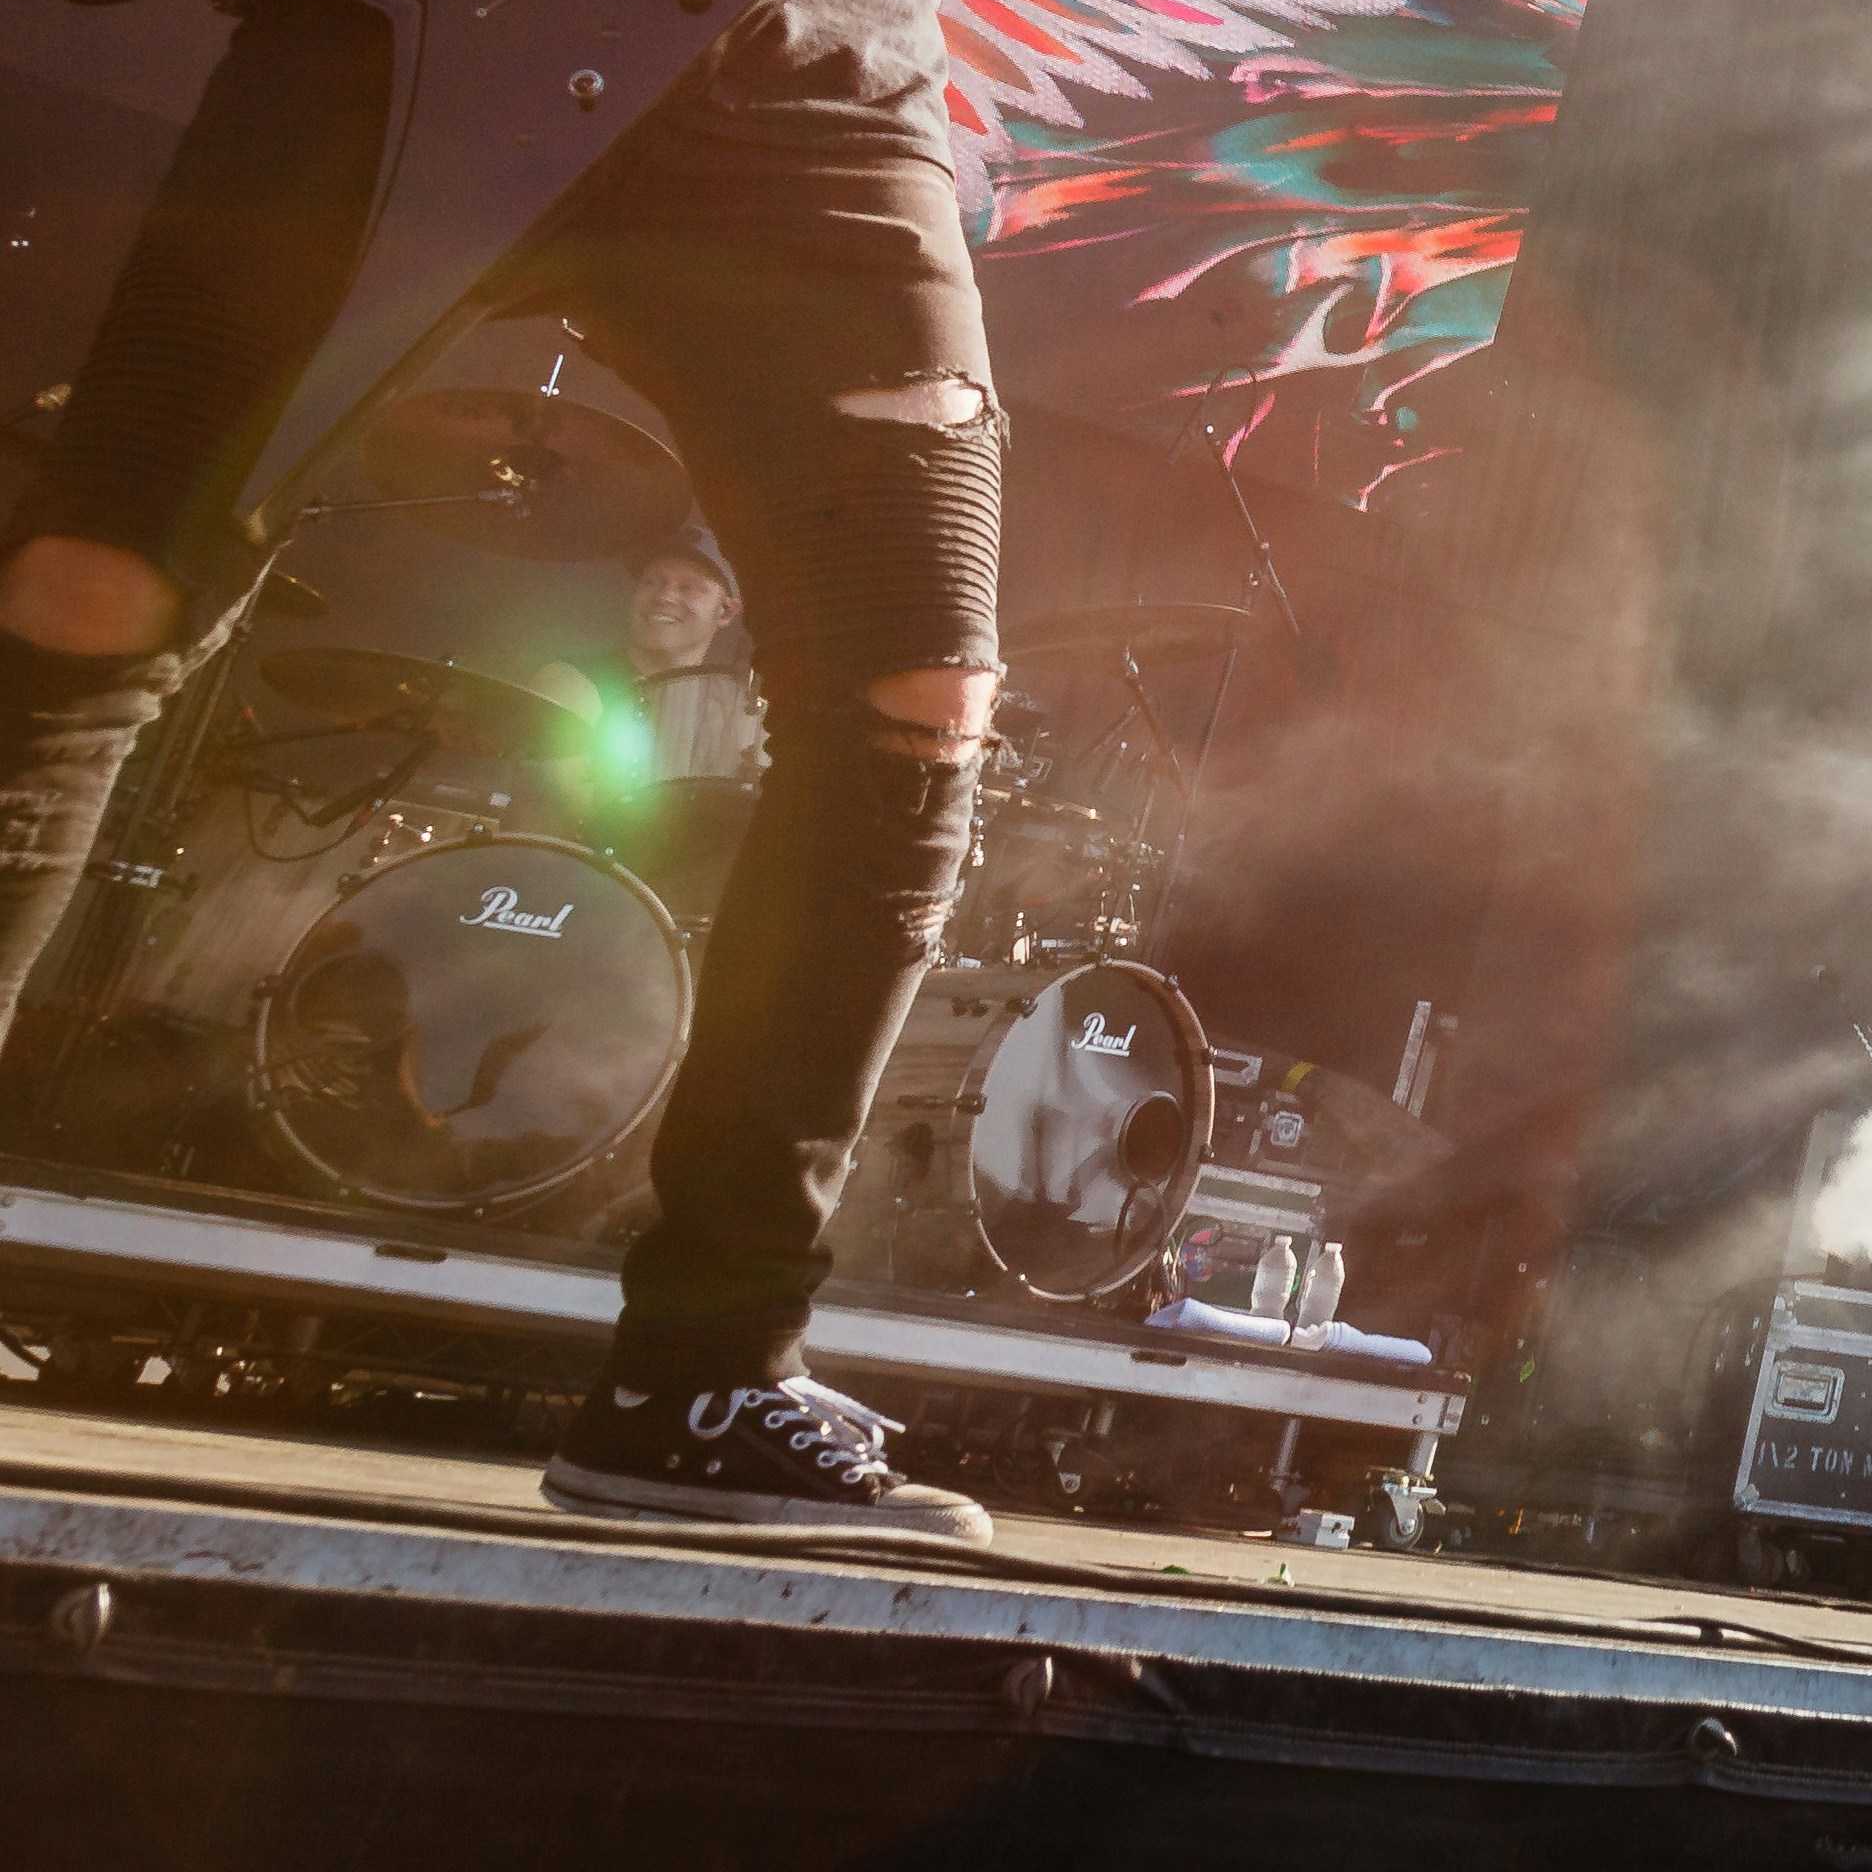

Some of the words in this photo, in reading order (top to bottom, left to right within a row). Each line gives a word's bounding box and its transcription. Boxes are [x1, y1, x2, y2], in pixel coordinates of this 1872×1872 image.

[458, 885, 575, 939] Pearl
[1070, 1011, 1137, 1057] Pearl
[1809, 1445, 1854, 1476] TON
